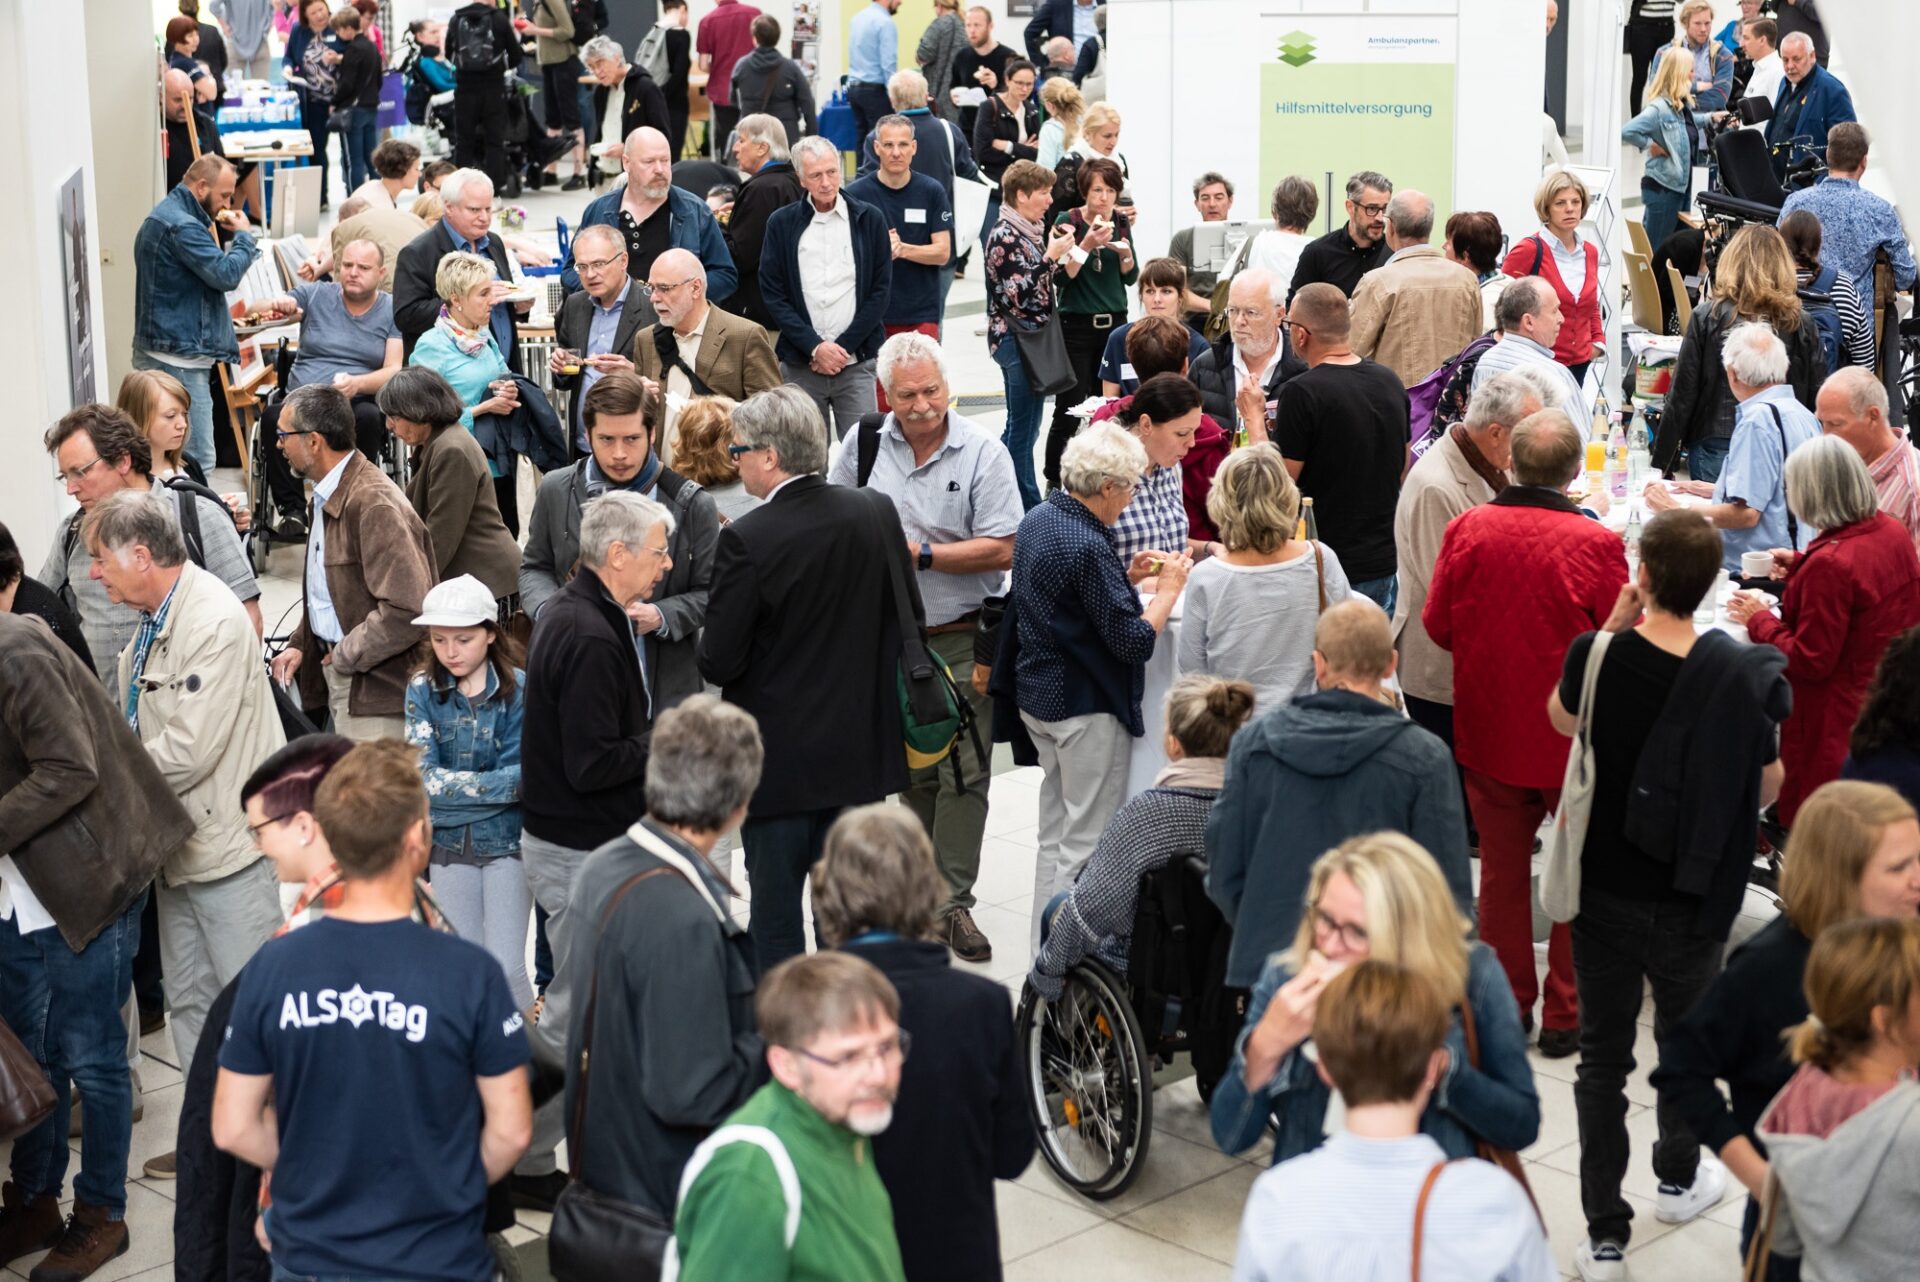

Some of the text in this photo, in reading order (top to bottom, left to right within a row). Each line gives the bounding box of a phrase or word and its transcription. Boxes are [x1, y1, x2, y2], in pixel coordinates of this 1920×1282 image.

[1276, 101, 1432, 117] Hilfsmittelversorgung
[279, 988, 428, 1042] ALS Tag
